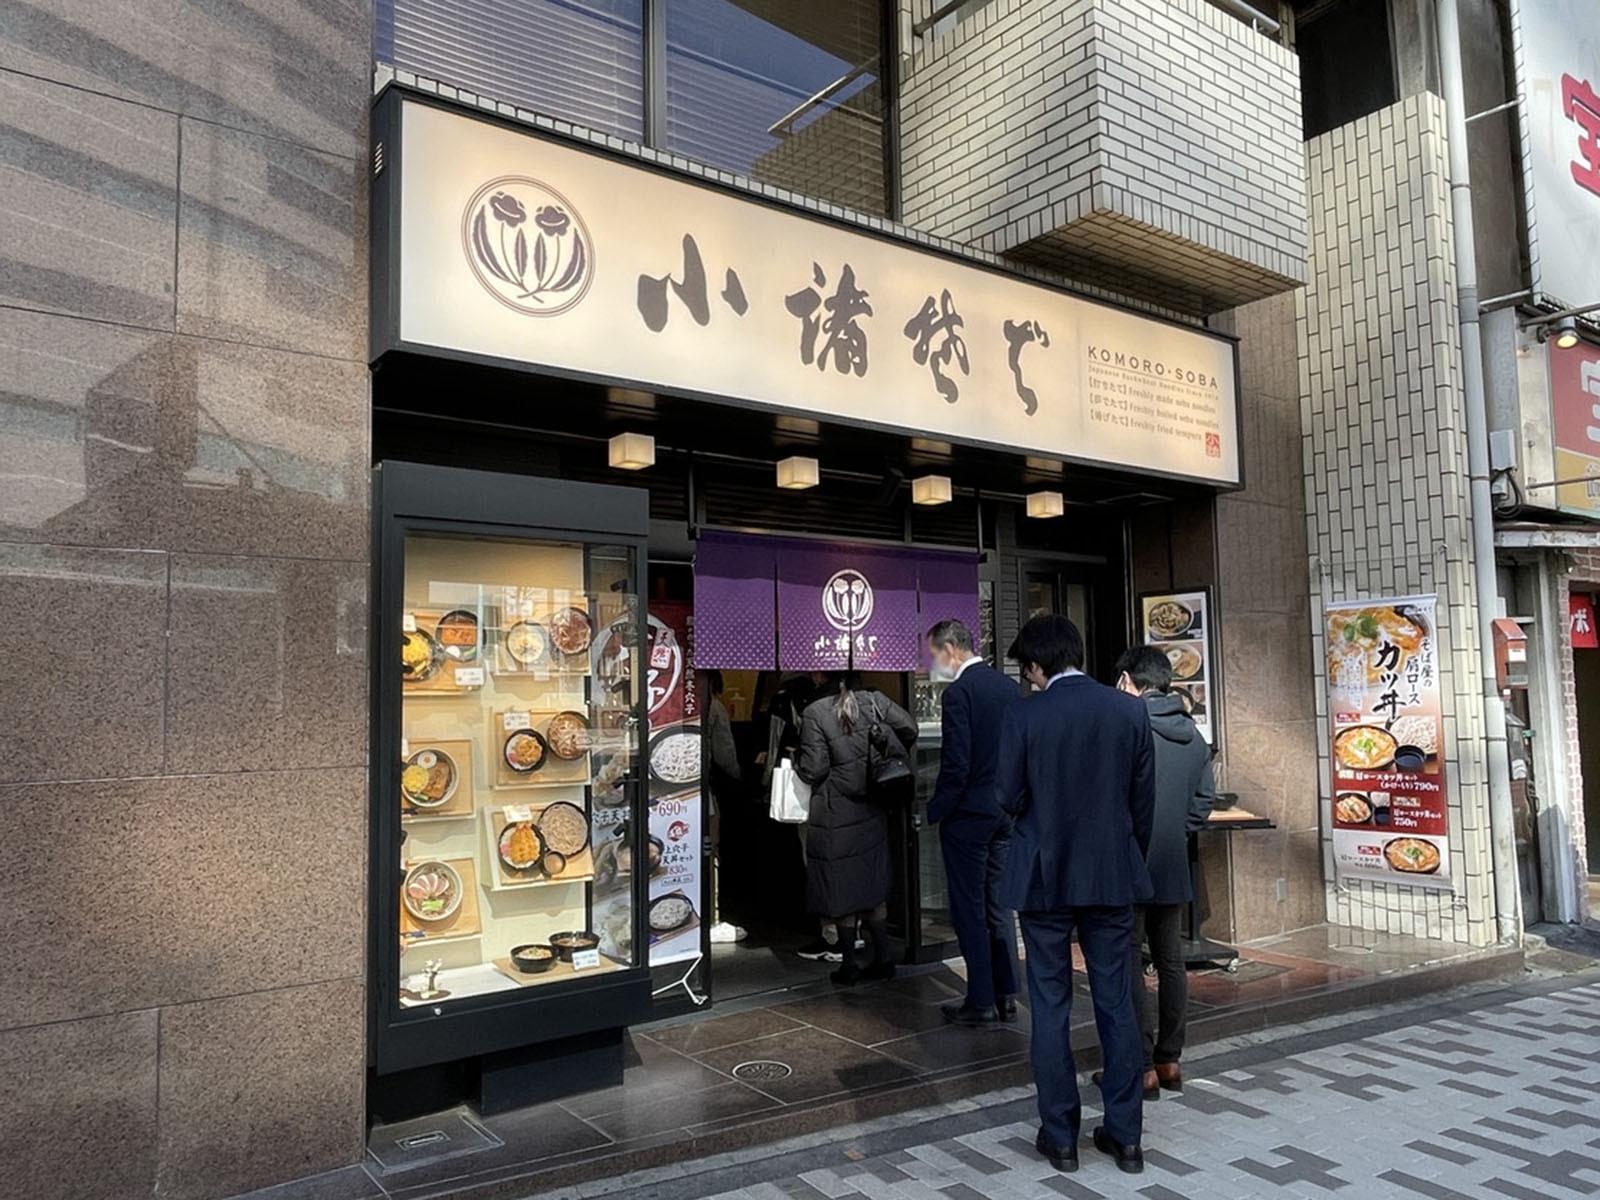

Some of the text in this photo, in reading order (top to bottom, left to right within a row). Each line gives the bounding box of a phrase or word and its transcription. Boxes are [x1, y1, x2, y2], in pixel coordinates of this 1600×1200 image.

[1372, 640, 1407, 731] カツ丼
[1405, 655, 1421, 705] 肩ロース
[1420, 638, 1433, 688] そば屋の
